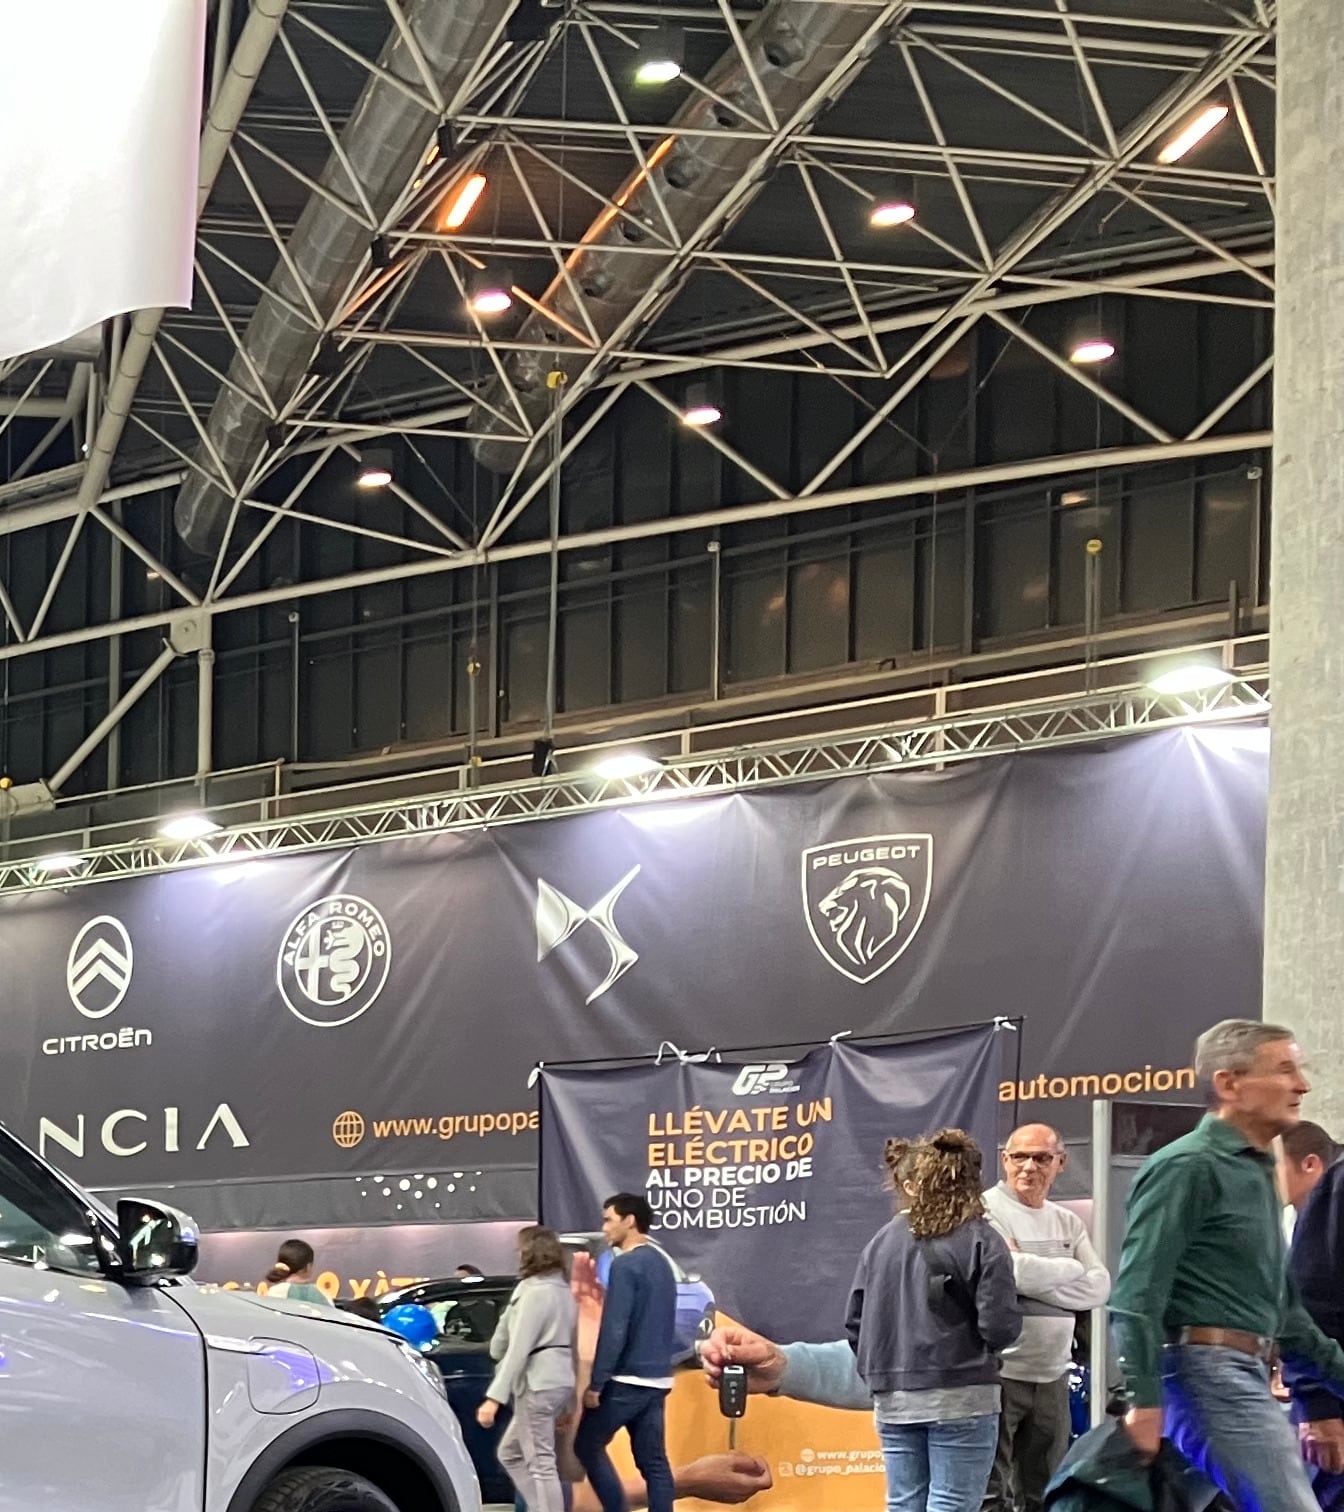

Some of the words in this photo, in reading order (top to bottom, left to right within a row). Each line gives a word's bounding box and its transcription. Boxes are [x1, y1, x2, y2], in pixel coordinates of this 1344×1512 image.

[812, 845, 921, 870] PEUGEOT
[283, 911, 321, 966] ALFA
[328, 901, 385, 957] ROMEO
[648, 1105, 789, 1137] LLÉVATE
[796, 1096, 832, 1127] UN
[647, 1132, 814, 1167] ELÉCTRICO
[645, 1168, 679, 1188] AL
[684, 1163, 781, 1188] PRECIO
[785, 1156, 813, 1182] DE
[647, 1188, 704, 1210] UNO
[711, 1186, 747, 1208] DE
